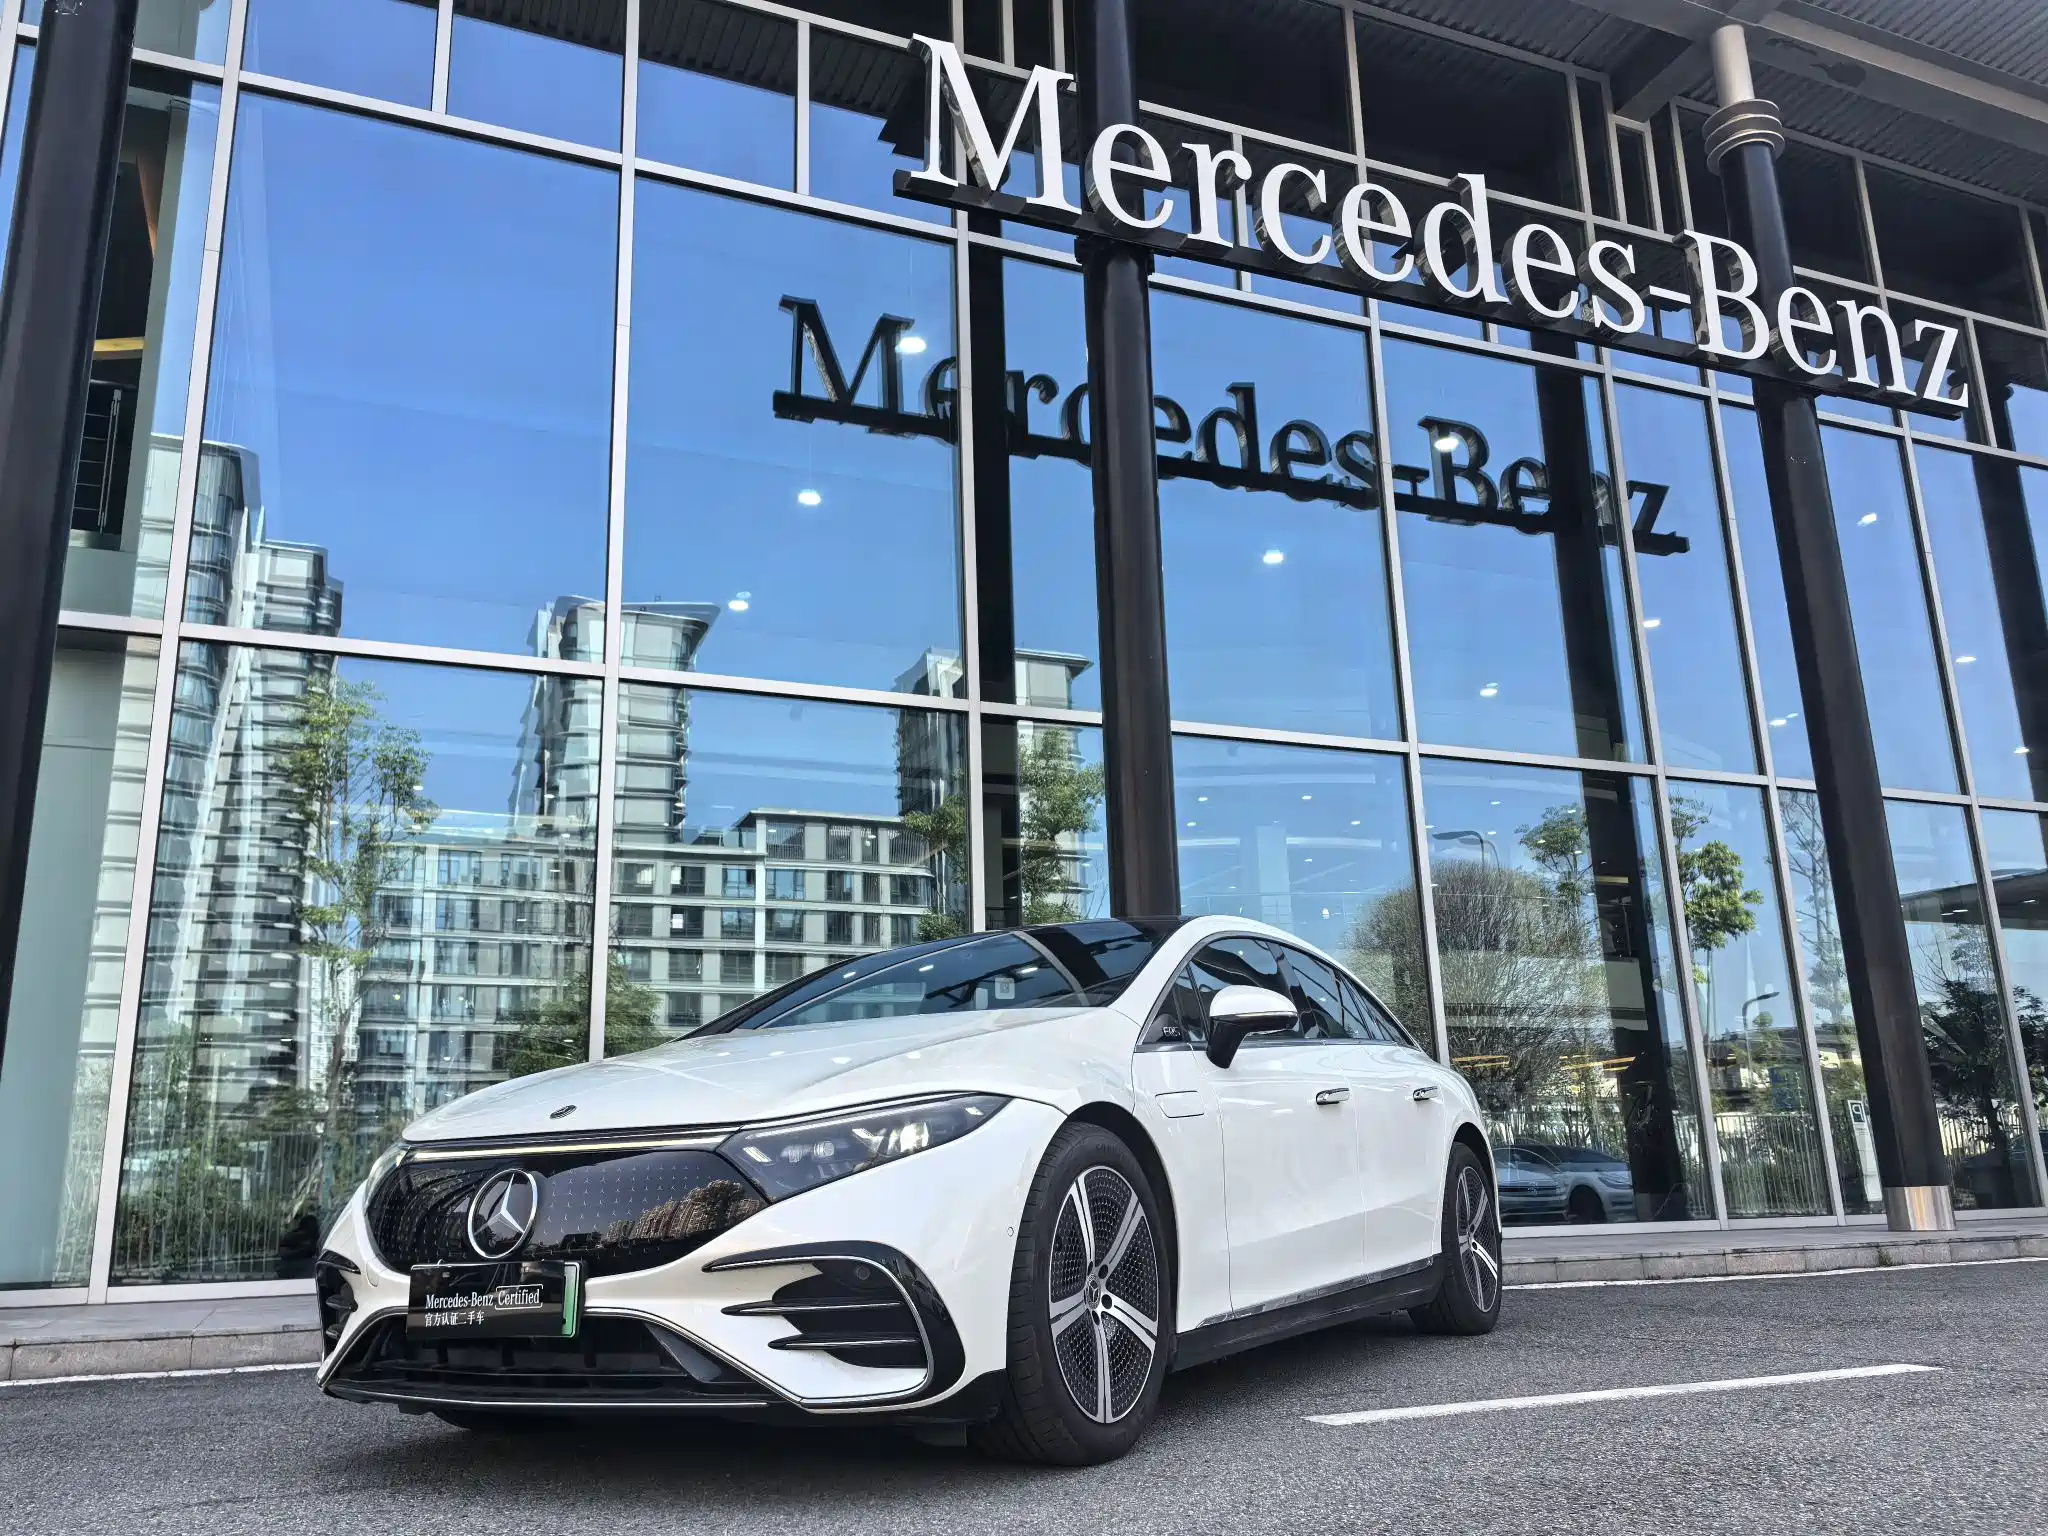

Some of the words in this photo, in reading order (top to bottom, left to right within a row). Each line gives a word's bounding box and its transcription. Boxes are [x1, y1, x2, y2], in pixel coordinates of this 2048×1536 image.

[911, 32, 1969, 408] Mercedes-Benz
[425, 1291, 494, 1310] Mercedes-Benz
[498, 1288, 540, 1306] Certified
[424, 1310, 485, 1327] 官方认证二手车
